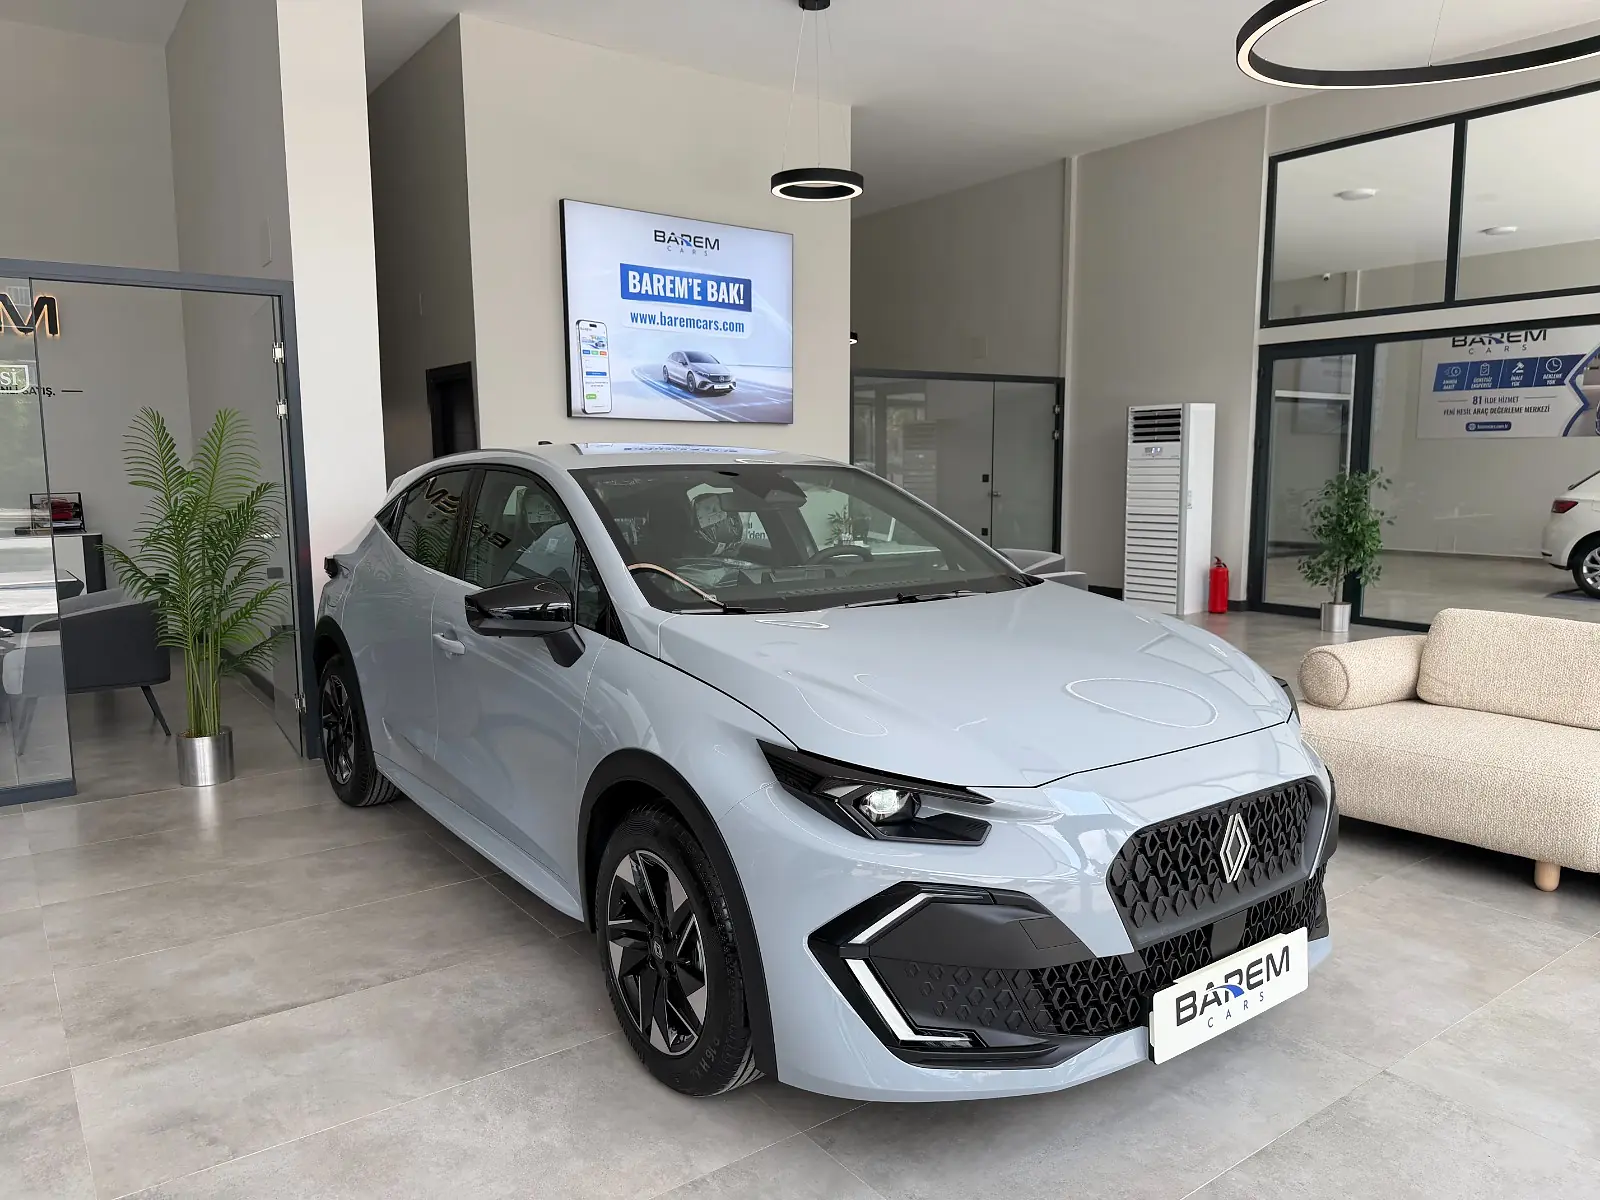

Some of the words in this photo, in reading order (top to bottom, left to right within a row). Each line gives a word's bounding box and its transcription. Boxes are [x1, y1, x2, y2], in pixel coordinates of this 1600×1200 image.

[653, 229, 720, 251] BAREM
[667, 246, 709, 257] CARS
[628, 270, 702, 300] BAREM'E
[706, 281, 745, 304] BAK!
[630, 311, 745, 333] www.baremcars.com
[1468, 344, 1528, 355] CARS
[1443, 407, 1455, 416] YENİ
[1472, 406, 1489, 416] ARAÇ
[1490, 405, 1524, 415] DEĞERLEME
[1524, 404, 1550, 413] MERKEZİ
[1472, 395, 1482, 405] 81
[1484, 395, 1496, 404] İLDE
[1498, 394, 1520, 403] HİZMET
[1175, 945, 1291, 1027] BAREM
[1207, 991, 1265, 1029] CARS
